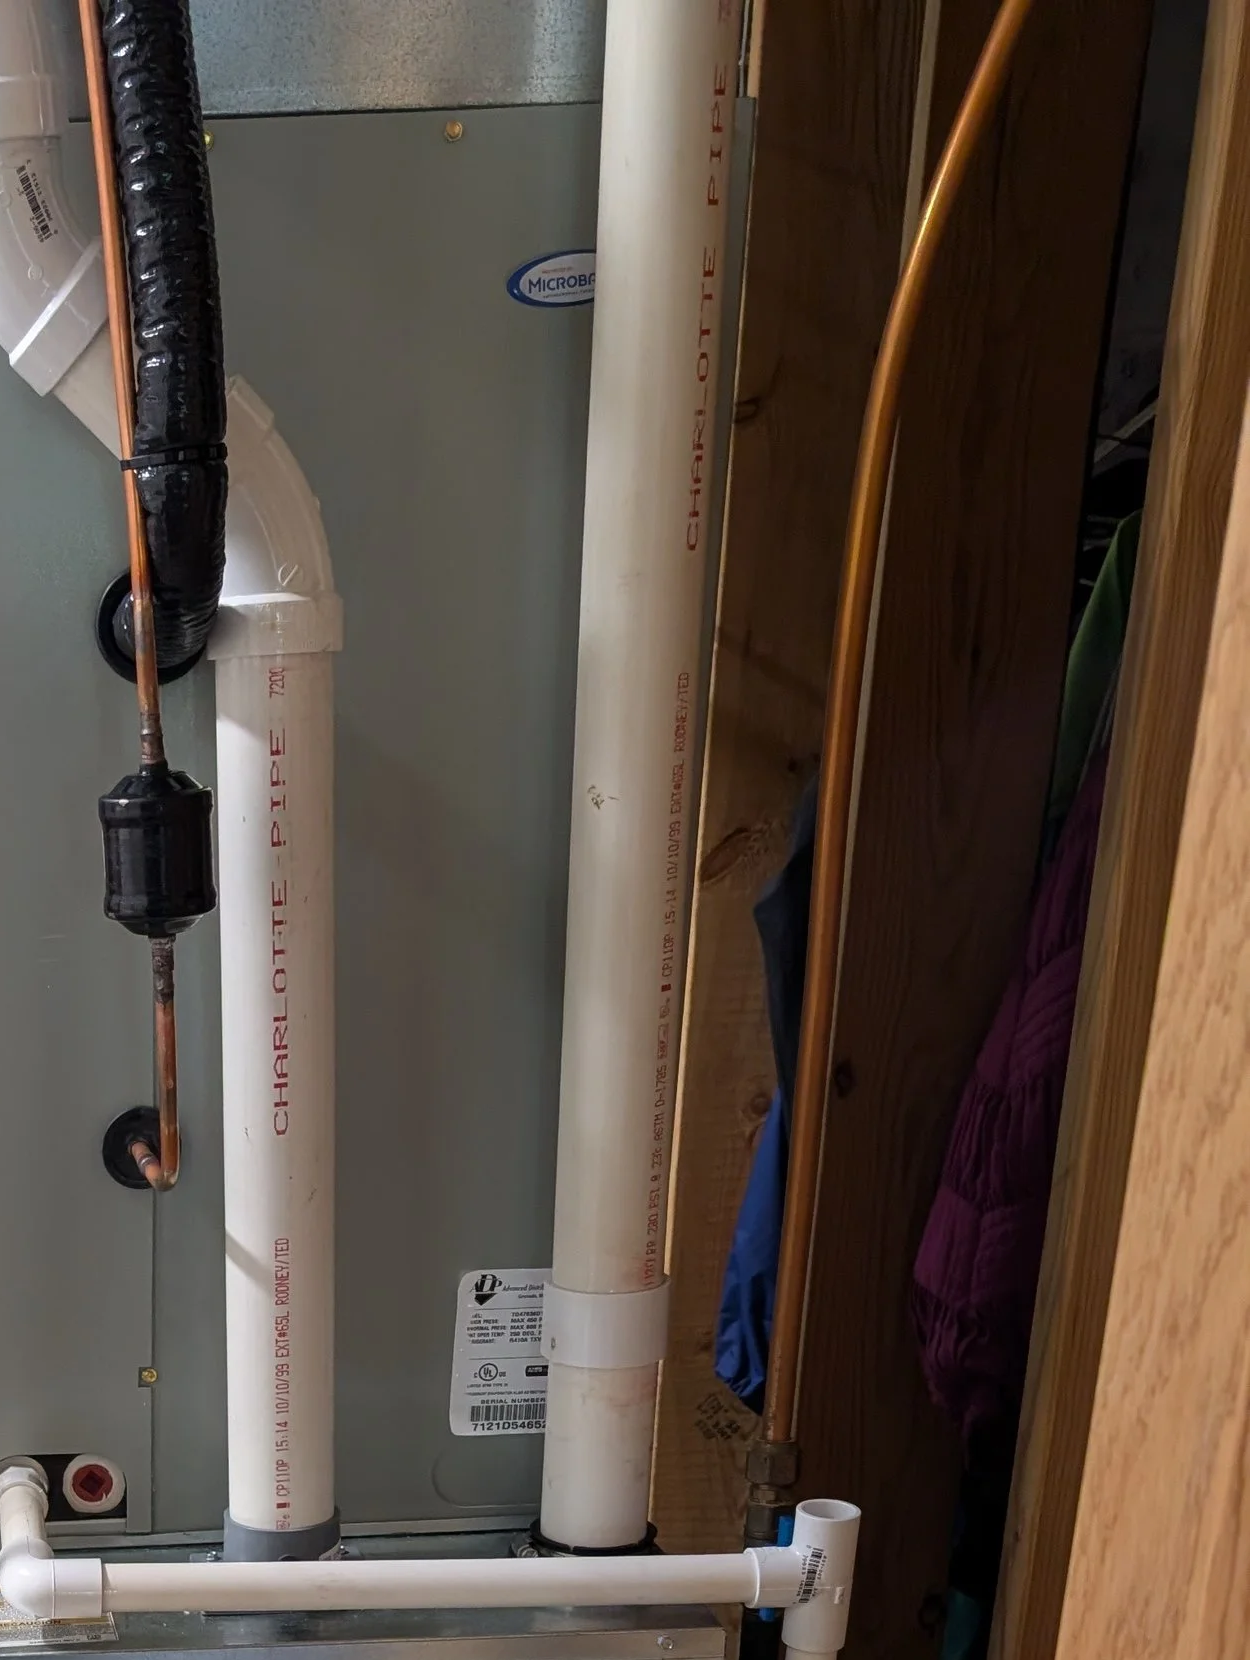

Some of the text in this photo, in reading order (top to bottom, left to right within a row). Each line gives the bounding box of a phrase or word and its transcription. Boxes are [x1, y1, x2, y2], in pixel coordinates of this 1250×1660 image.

[686, 63, 727, 551] CHARLOTTE PIPE
[269, 727, 289, 1137] CHARLOTTE PIPE
[274, 1236, 290, 1306] RODNEY/TED
[274, 1310, 290, 1358] EXT#65L
[274, 1363, 291, 1415] 10/10/99
[274, 1419, 290, 1453] 15:14
